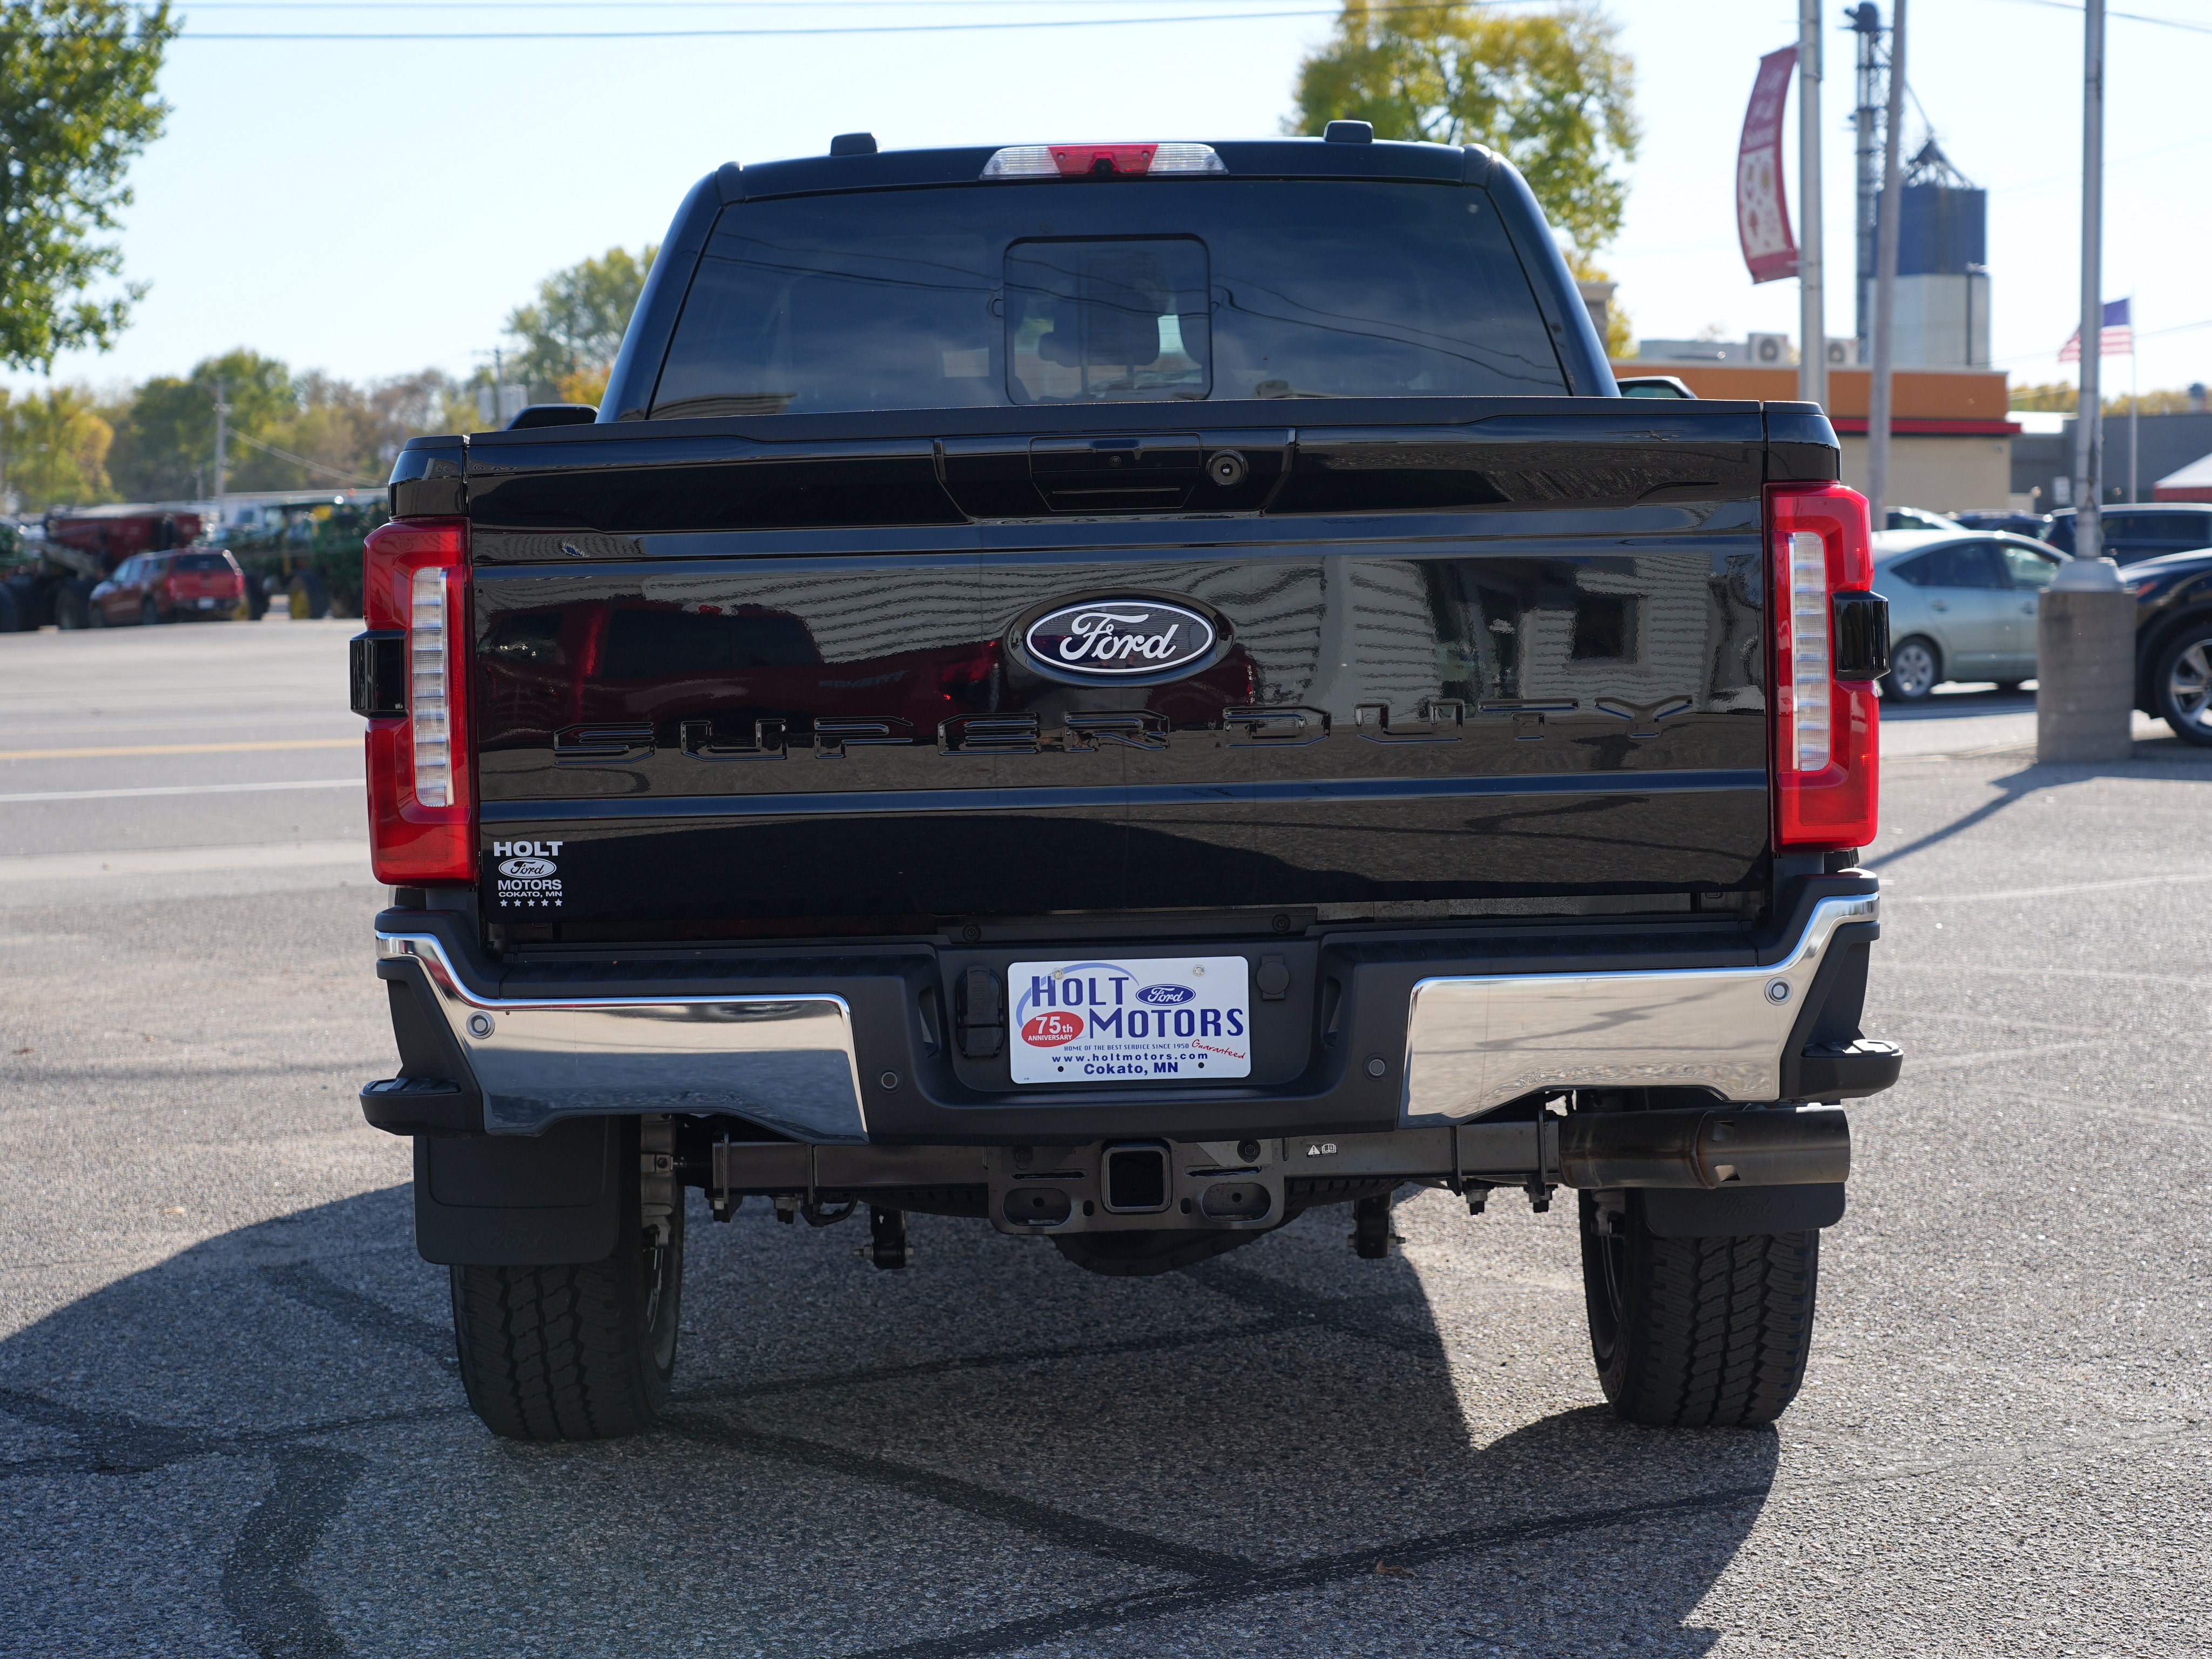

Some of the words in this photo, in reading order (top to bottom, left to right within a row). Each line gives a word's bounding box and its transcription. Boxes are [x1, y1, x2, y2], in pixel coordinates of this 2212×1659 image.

[1060, 612, 1179, 660] Ford
[554, 709, 1171, 766] SUPER
[1222, 694, 1694, 748] DUTY
[494, 841, 563, 857] HOLT
[510, 861, 545, 874] Ford
[498, 879, 562, 890] MOTORS
[1031, 976, 1129, 1007] HOLT
[1148, 987, 1184, 1002] Ford
[1036, 1016, 1073, 1034] 75th
[1089, 1008, 1244, 1039] MOTORS
[1052, 1053, 1208, 1062] www.holtmotors.com
[1191, 1039, 1246, 1060] Guaranteed
[1084, 1063, 1148, 1076] Cokato,
[1154, 1062, 1178, 1073] MN
[1716, 1195, 1774, 1218] Ford
[488, 1225, 545, 1250] Ford
